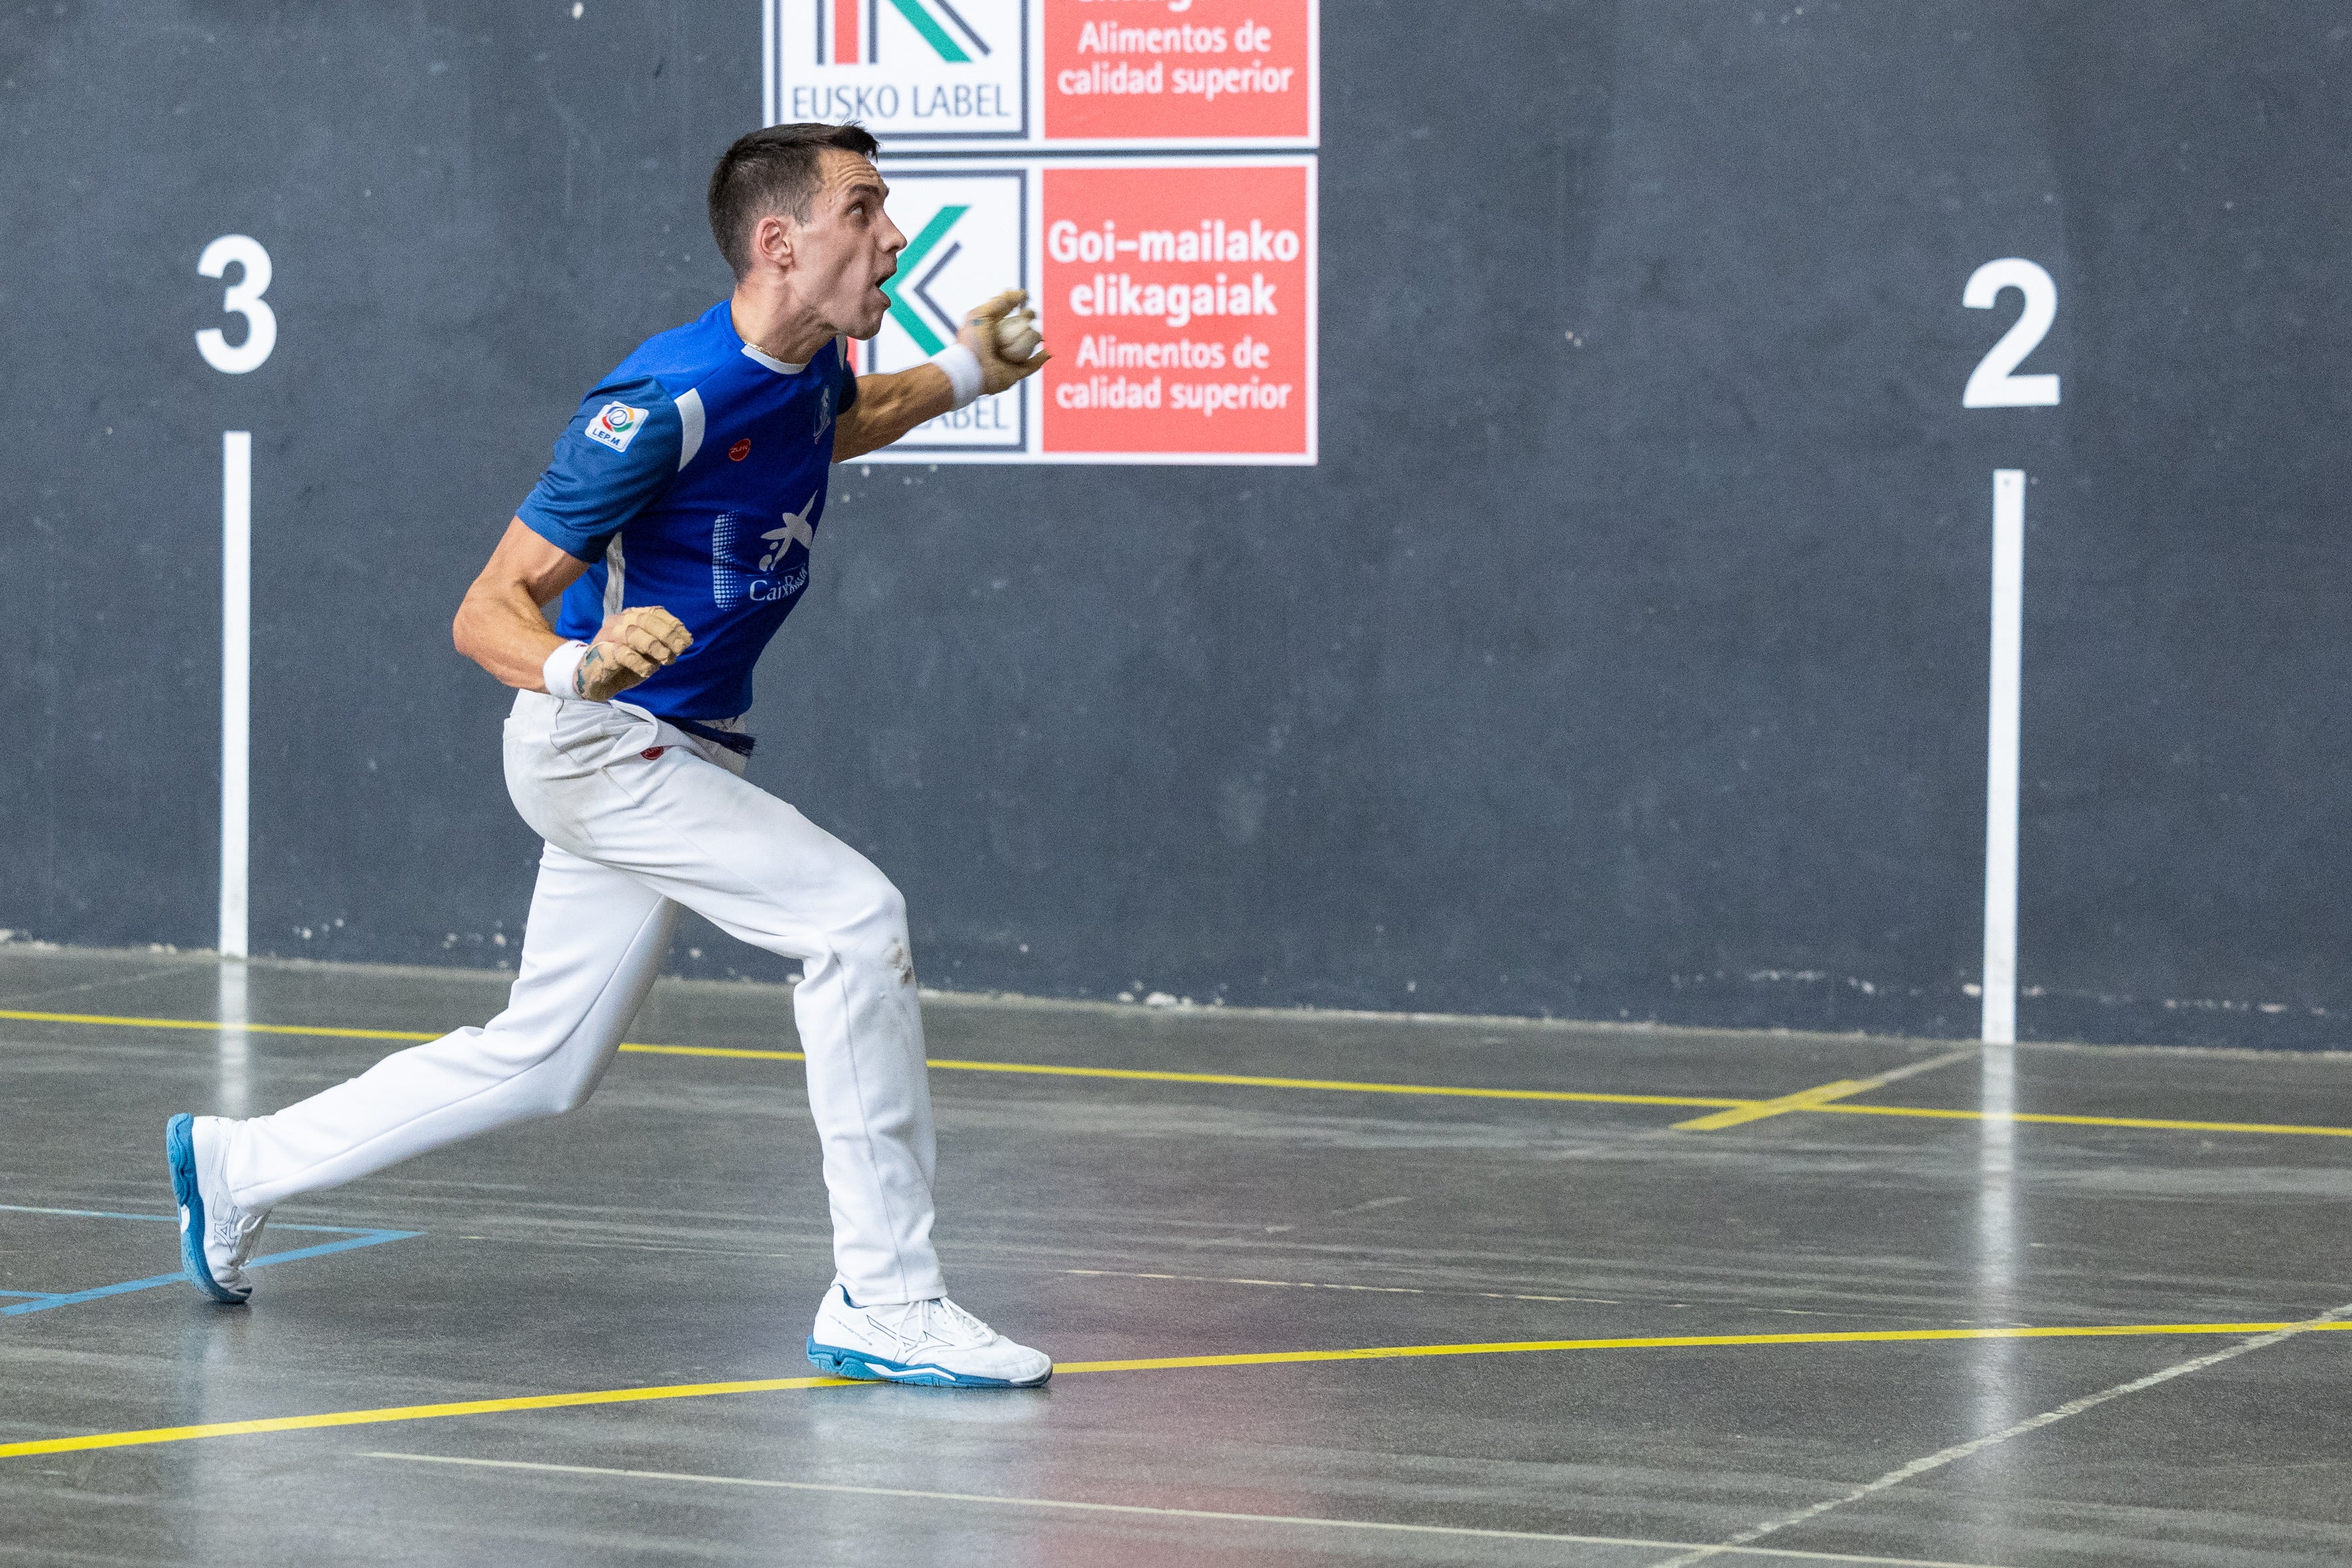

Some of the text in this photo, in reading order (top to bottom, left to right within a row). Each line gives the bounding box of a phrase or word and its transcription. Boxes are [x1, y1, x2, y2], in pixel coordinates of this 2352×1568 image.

[1077, 19, 1272, 54] Alimentos de
[793, 84, 1012, 119] EUSKO LABEL
[1058, 58, 1294, 102] calidad superior
[1048, 218, 1300, 264] Goi-mailako
[195, 234, 277, 374] 3
[1069, 272, 1278, 328] elikagaiak
[1075, 335, 1271, 369] Alimentos de
[1962, 258, 2060, 408] 2
[1056, 374, 1293, 418] calidad superior
